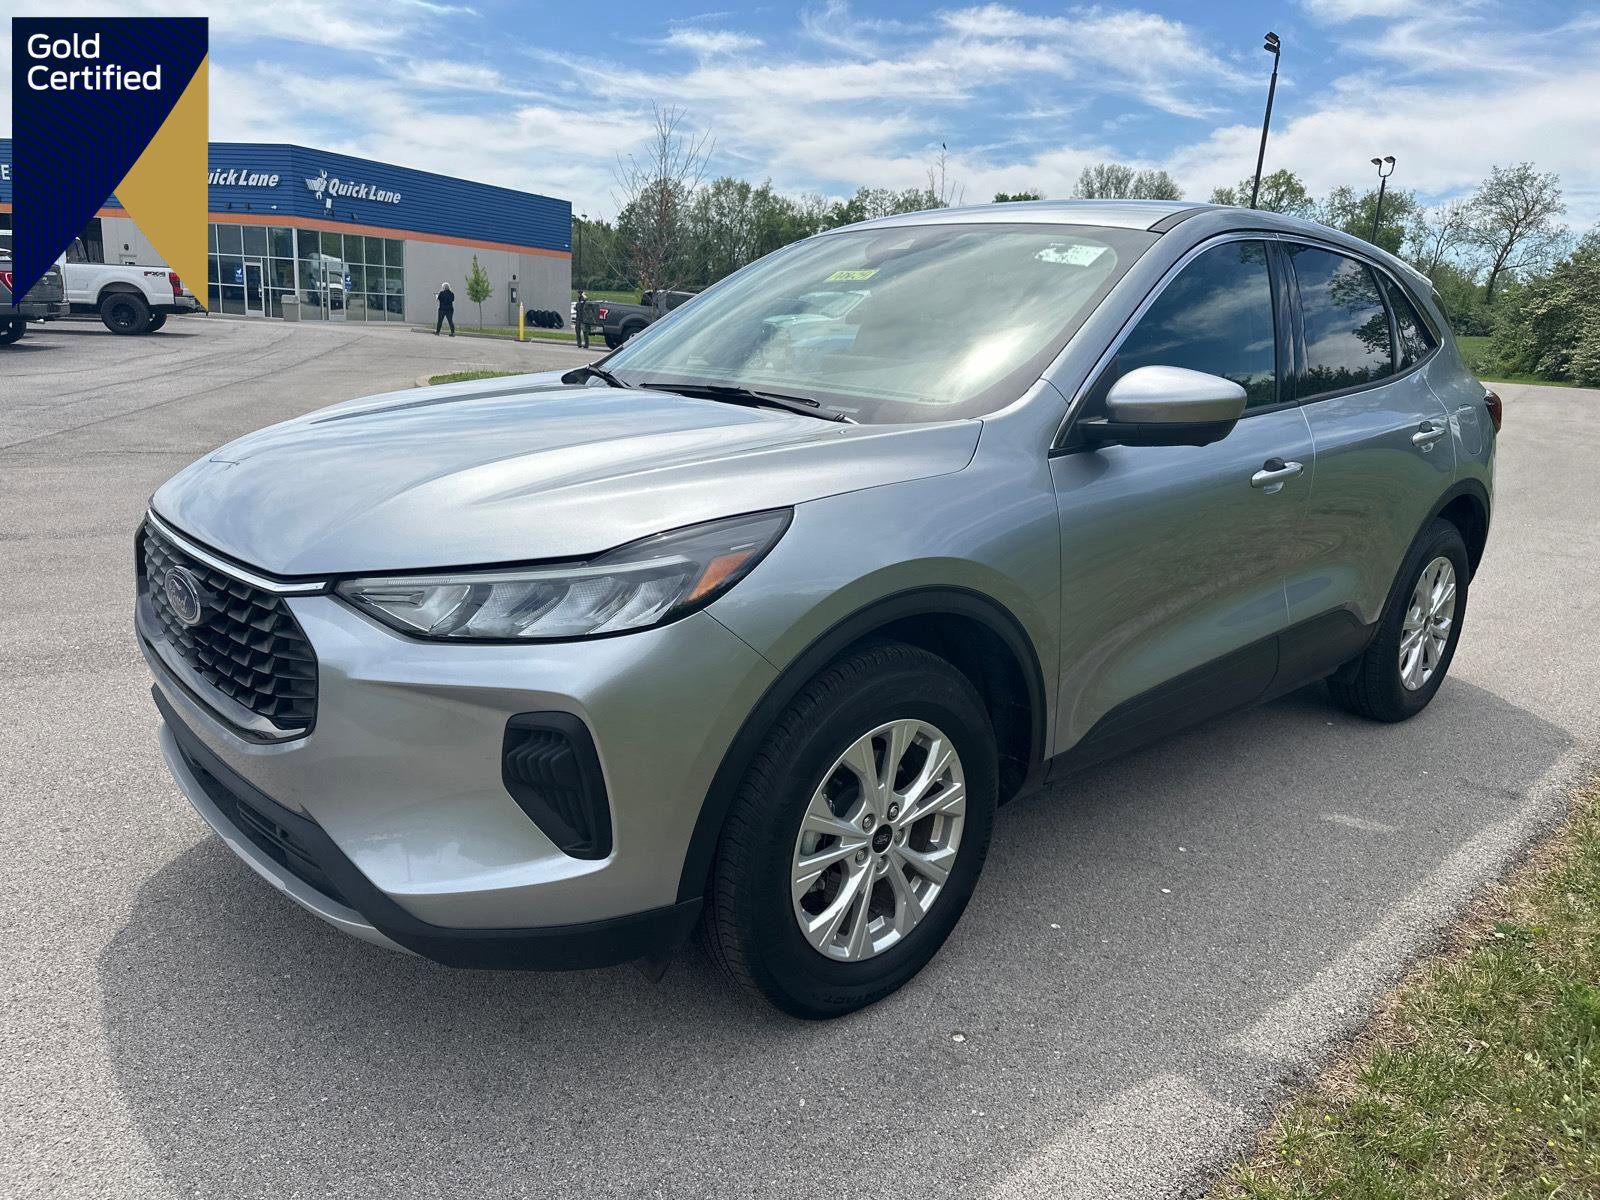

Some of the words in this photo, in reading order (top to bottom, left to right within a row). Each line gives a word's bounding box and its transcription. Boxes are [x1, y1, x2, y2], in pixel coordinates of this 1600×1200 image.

[239, 170, 279, 187] Lane
[329, 178, 368, 198] Quick
[369, 186, 402, 204] Lane
